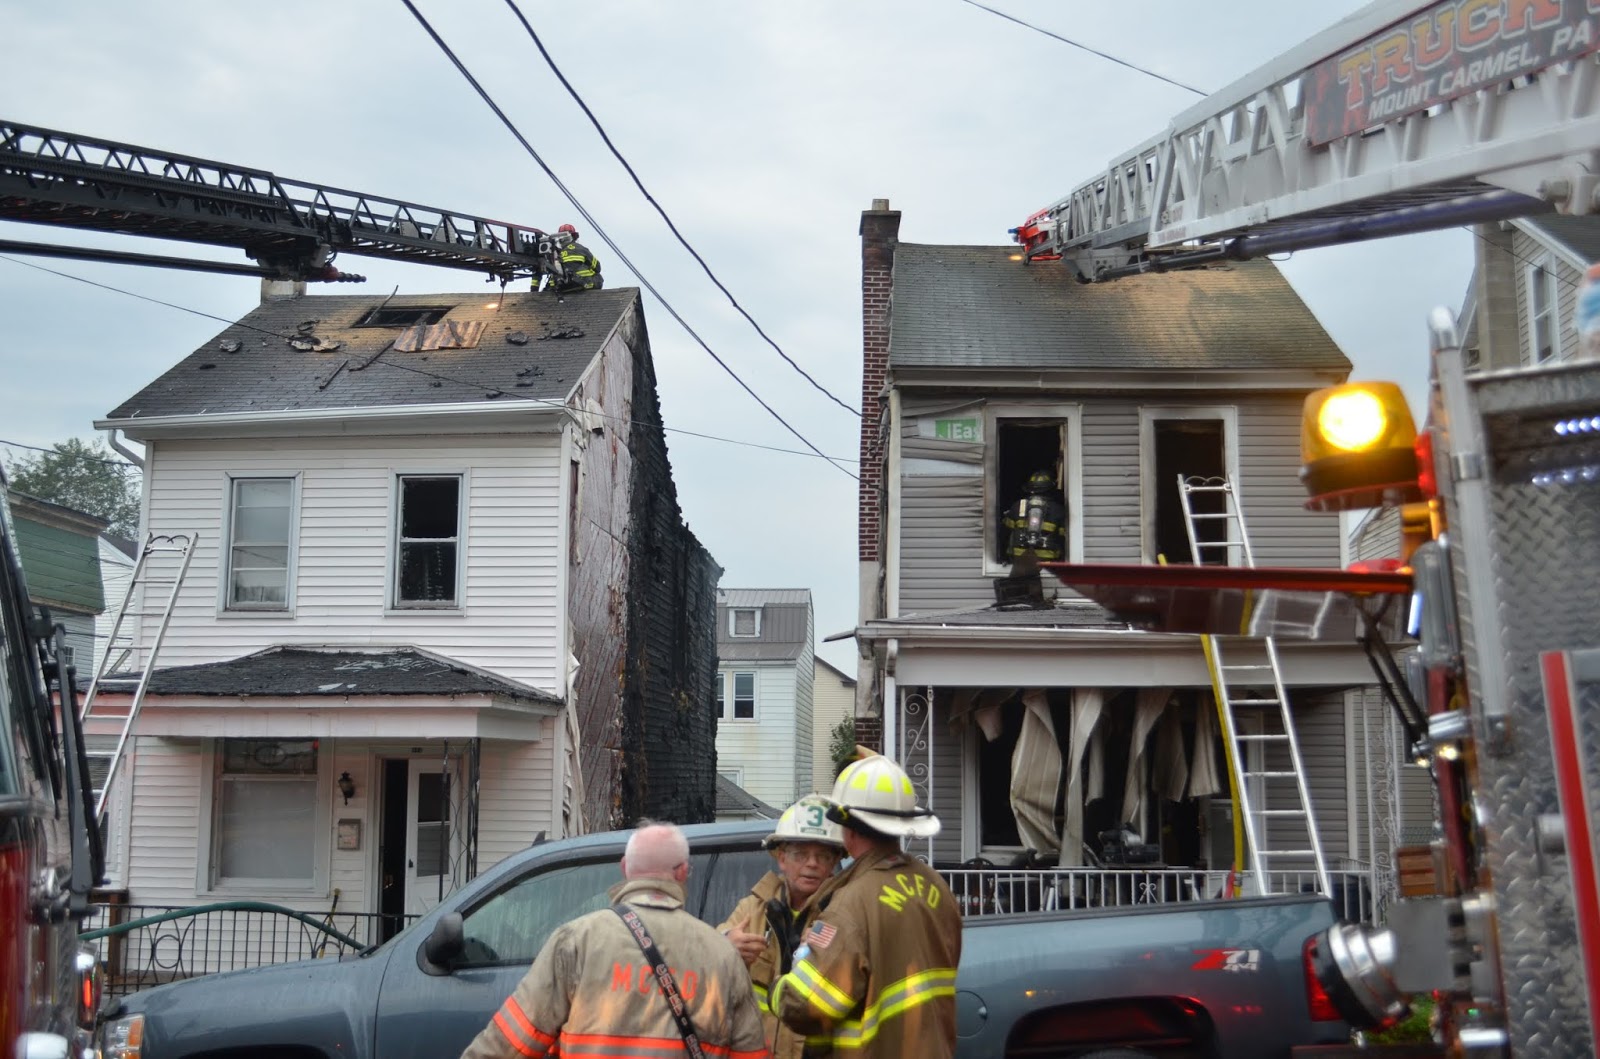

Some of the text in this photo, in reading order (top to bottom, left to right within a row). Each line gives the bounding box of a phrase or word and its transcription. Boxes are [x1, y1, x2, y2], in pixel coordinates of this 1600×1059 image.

[1368, 18, 1590, 121] MOUNT CARMEL, PA
[806, 805, 824, 827] 3
[879, 873, 940, 912] MCFD
[611, 961, 698, 1000] MCD
